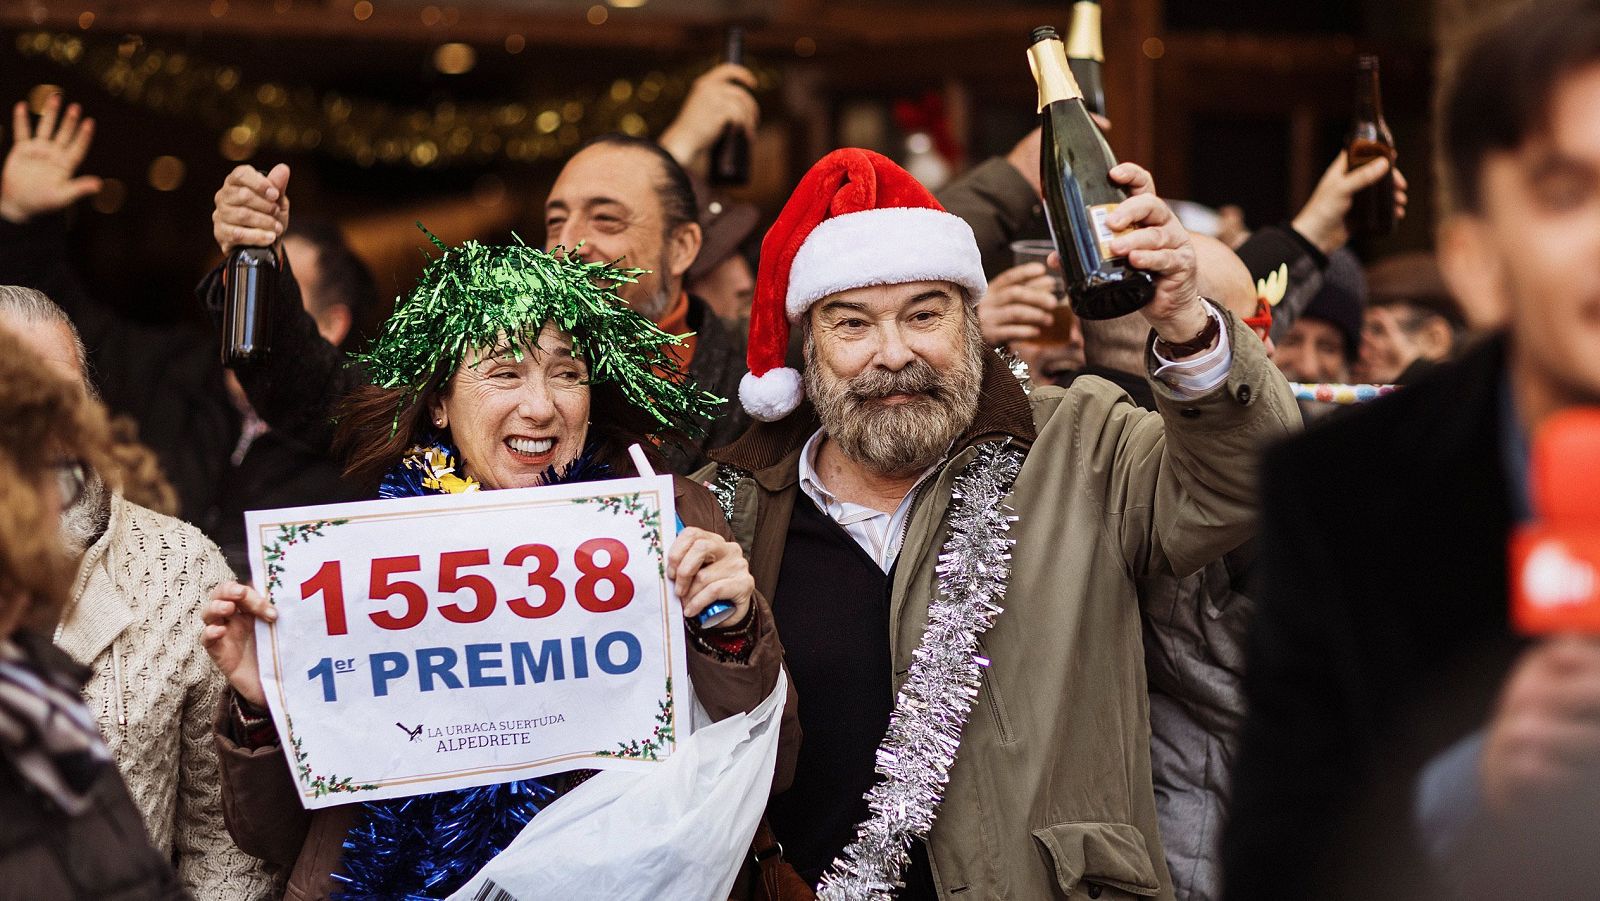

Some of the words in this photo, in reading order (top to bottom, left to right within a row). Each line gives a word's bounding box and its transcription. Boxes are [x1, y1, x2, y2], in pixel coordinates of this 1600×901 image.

[300, 538, 635, 636] 15538
[307, 656, 355, 703] 1er
[369, 630, 643, 697] PREMIO
[427, 728, 443, 738] LA
[446, 721, 497, 736] URRACA
[499, 713, 566, 731] SUERTUDA
[436, 732, 531, 753] ALPEDRETE
